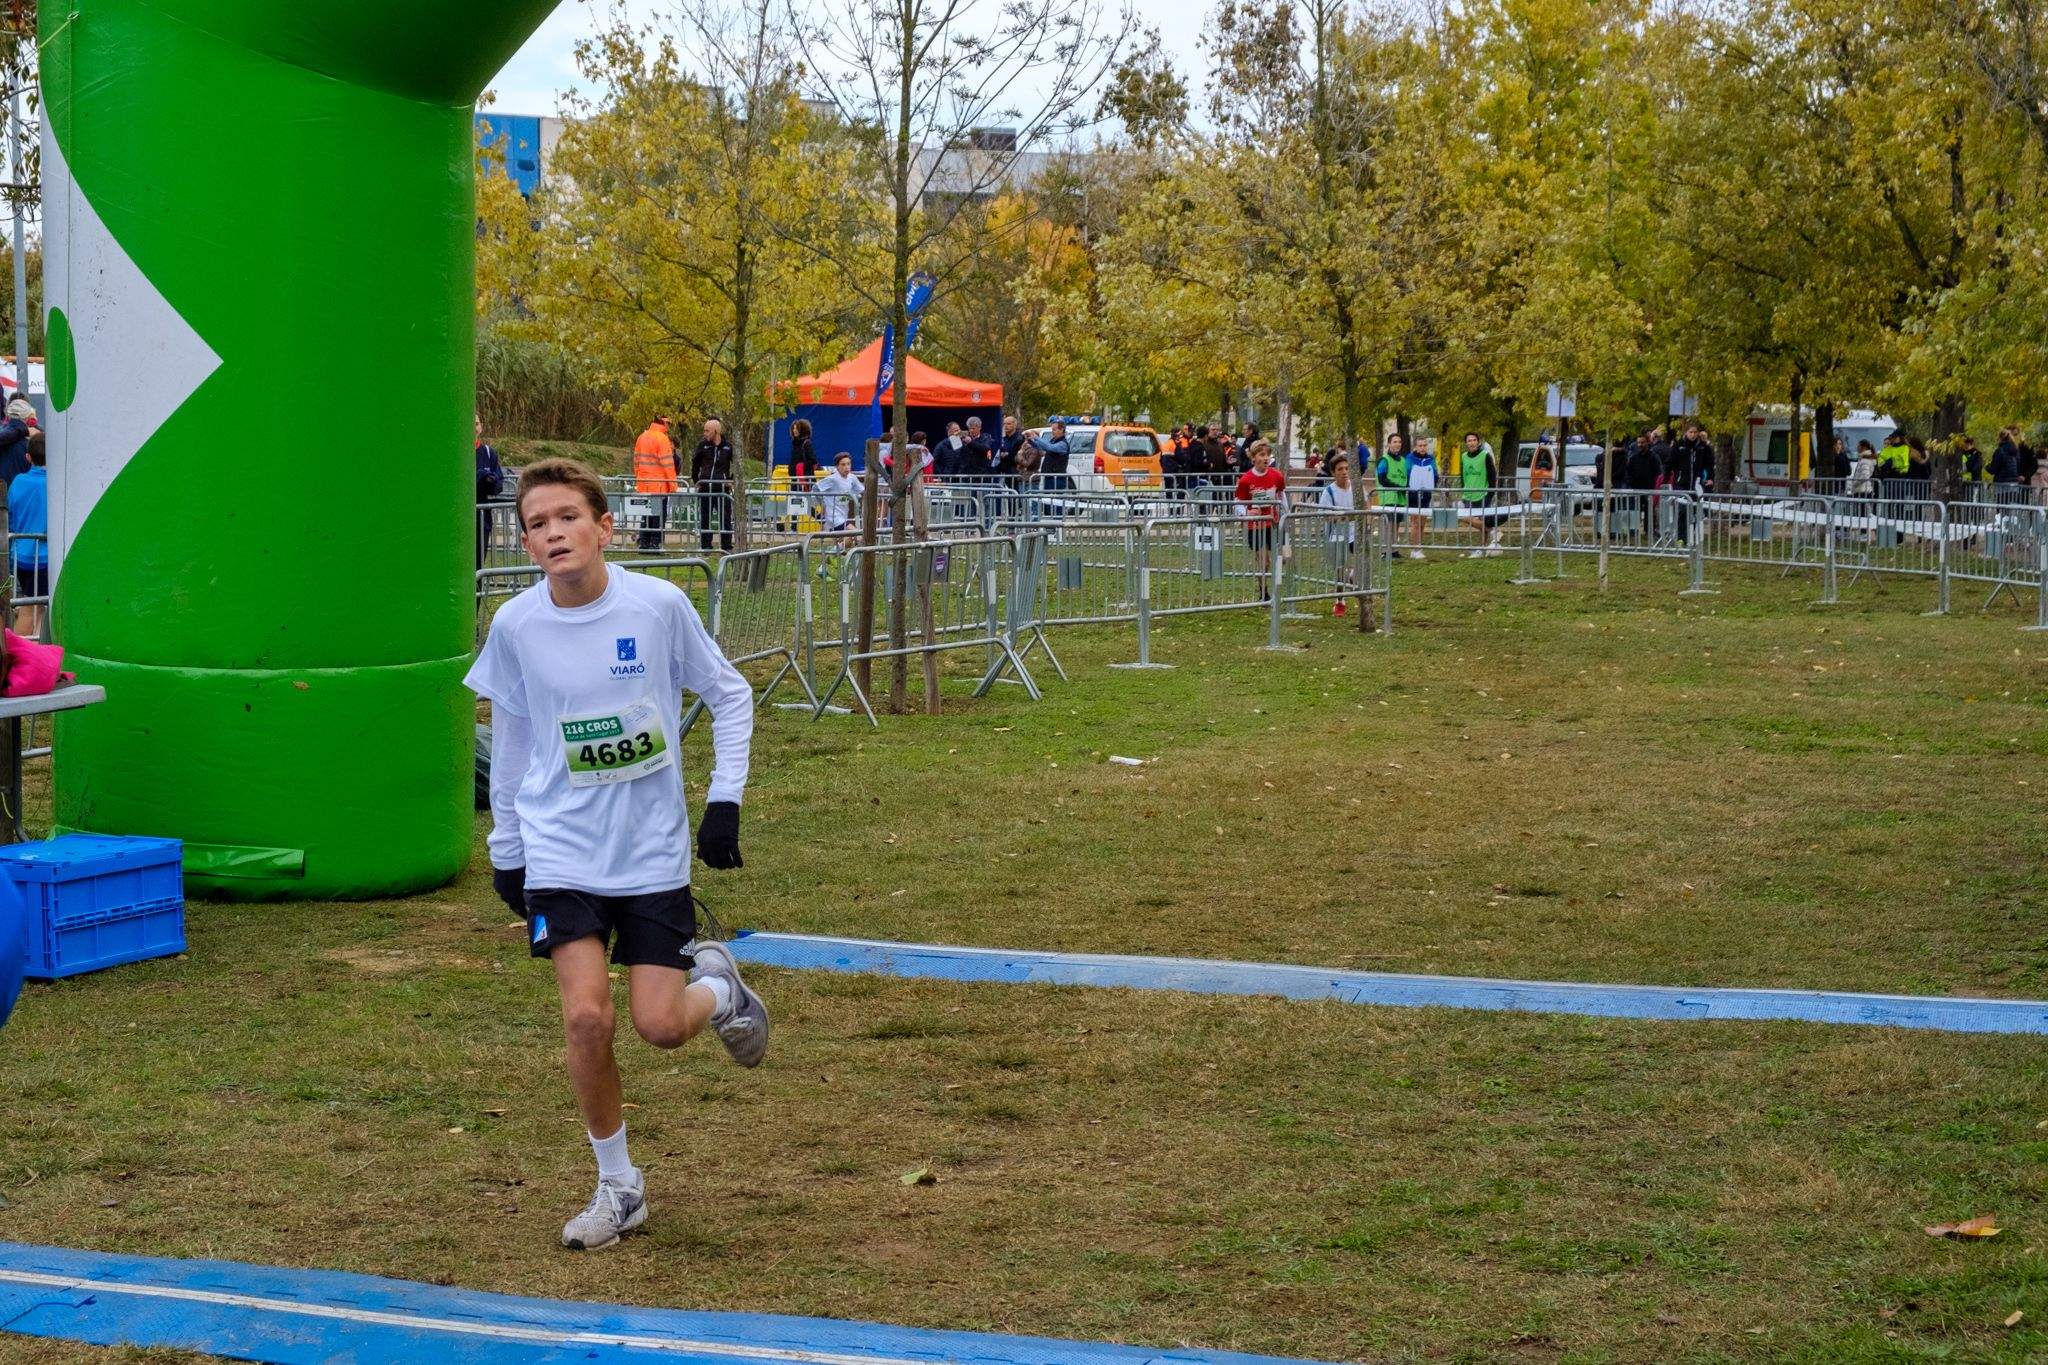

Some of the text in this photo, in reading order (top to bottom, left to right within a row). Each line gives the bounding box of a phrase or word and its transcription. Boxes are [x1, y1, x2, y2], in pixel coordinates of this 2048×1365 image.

[906, 280, 918, 305] civi
[610, 662, 645, 675] VIARÓ
[564, 719, 618, 735] 21è CROS
[579, 732, 654, 767] 4683
